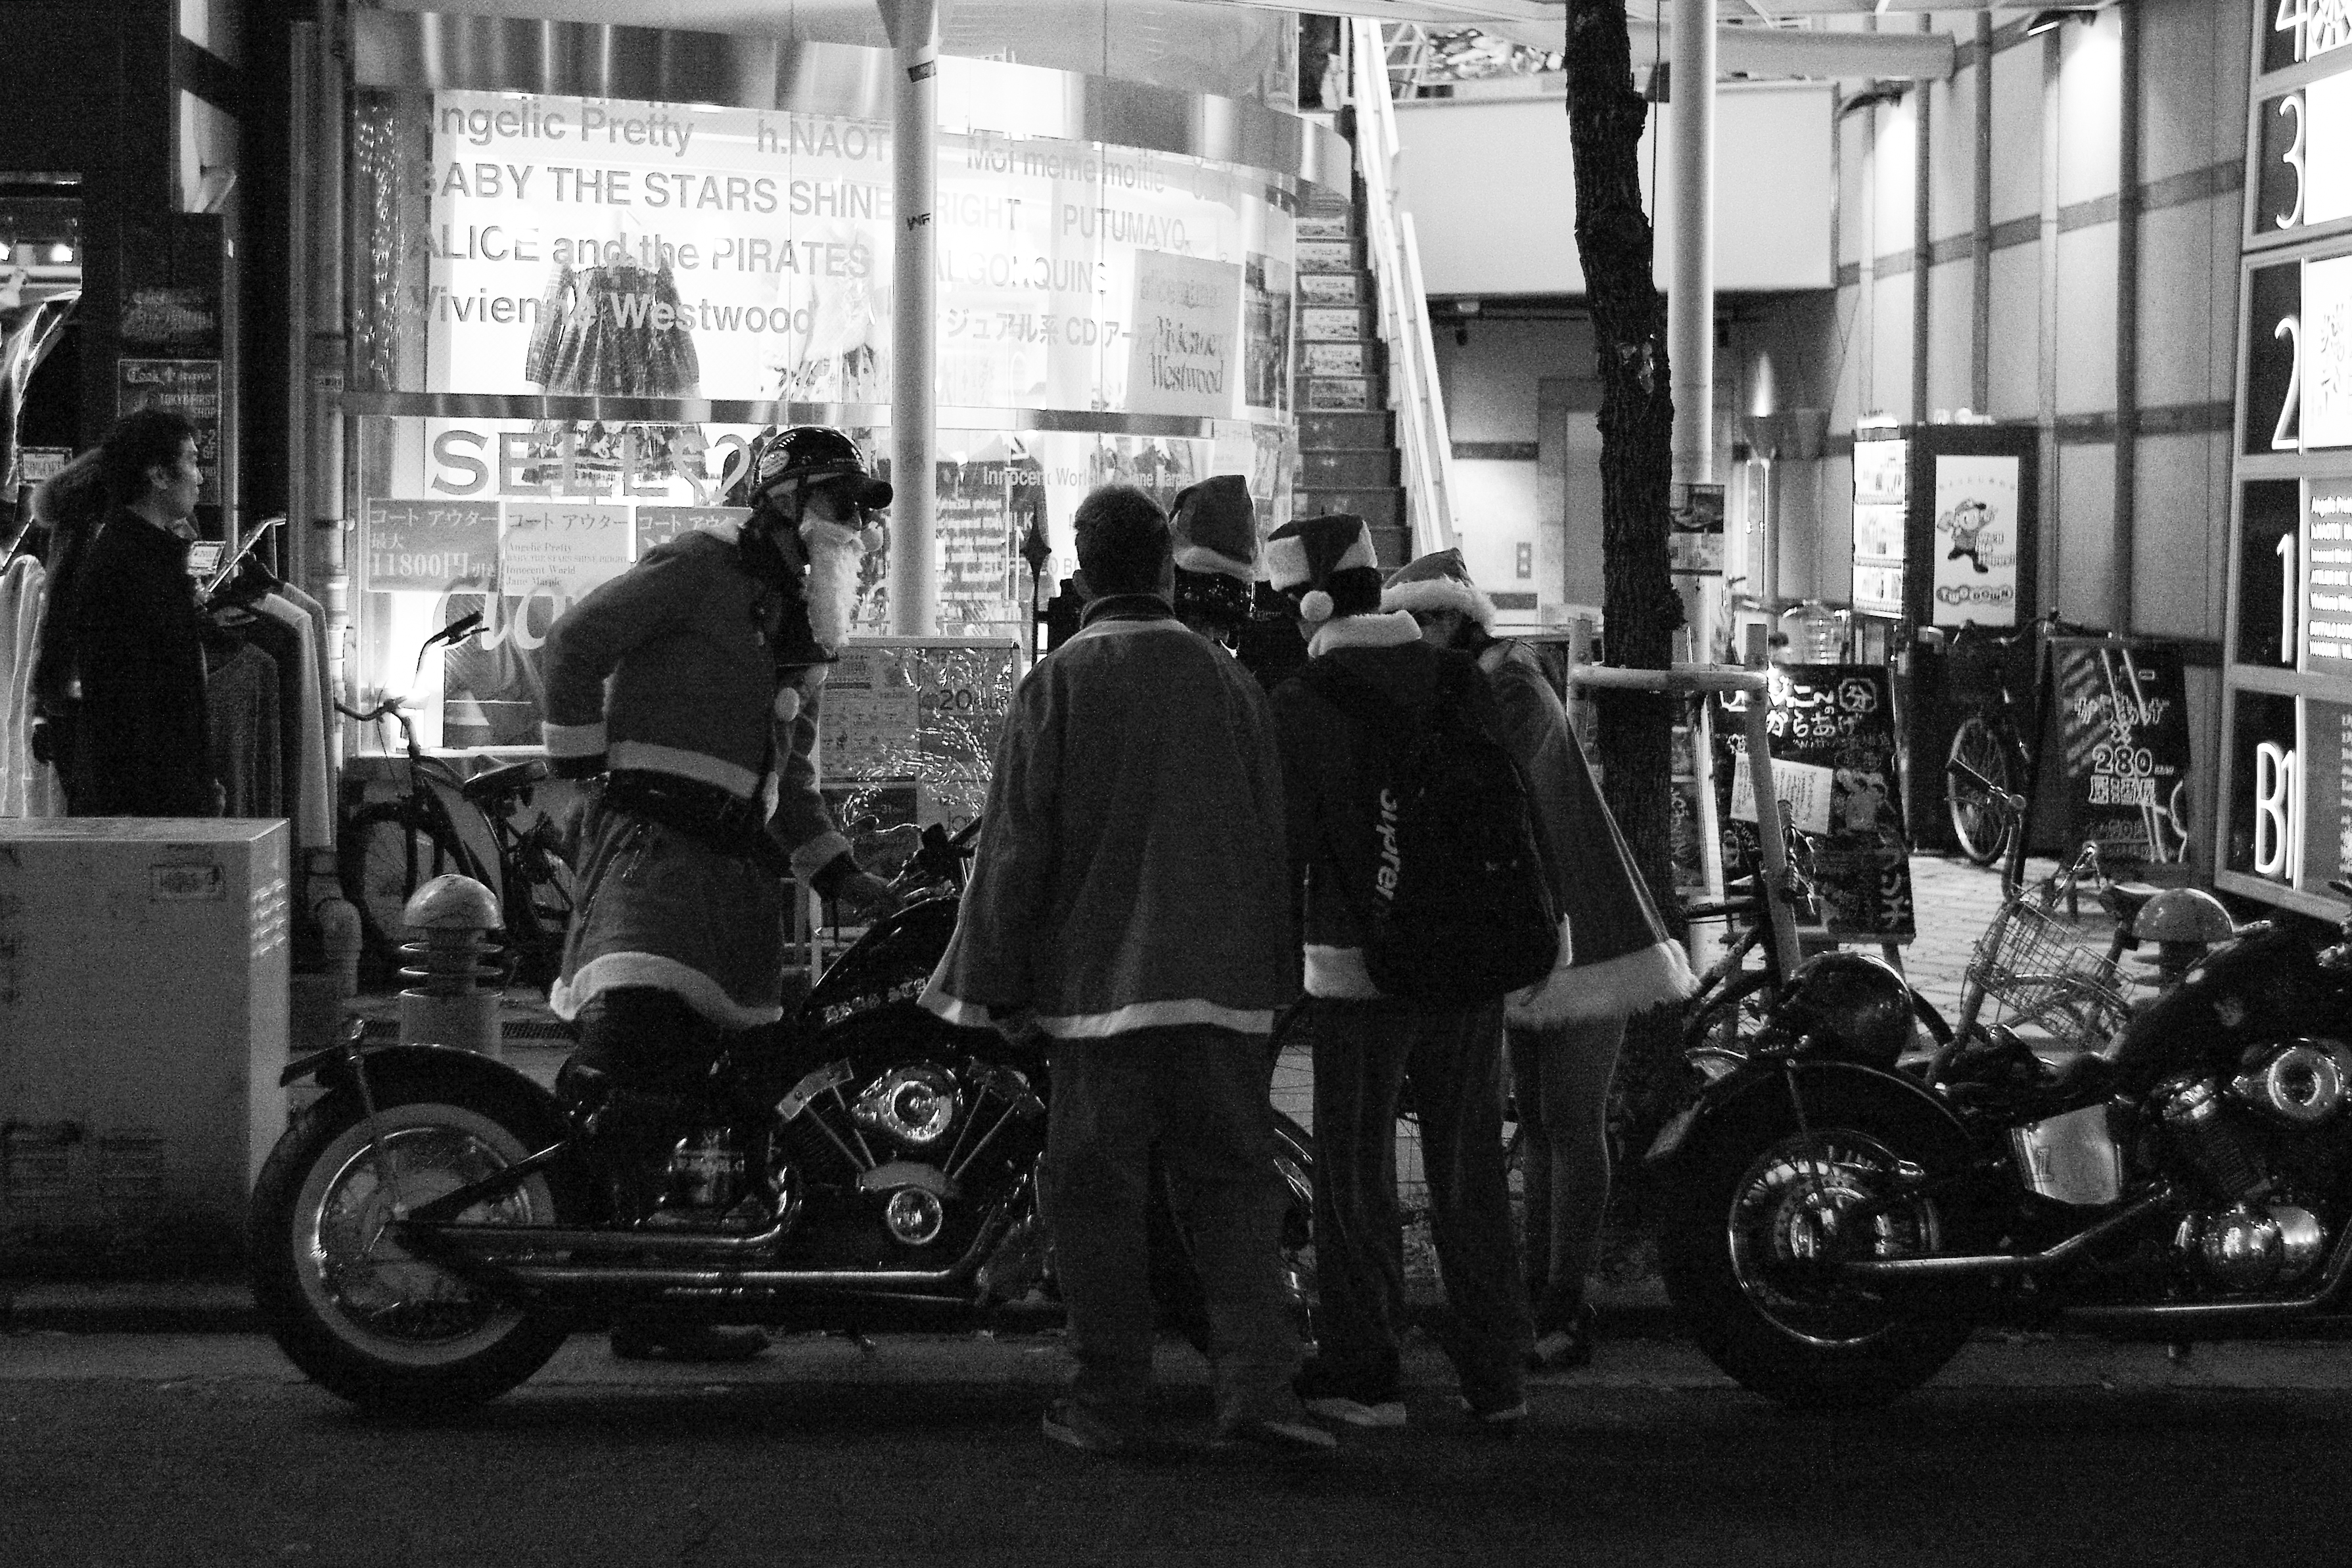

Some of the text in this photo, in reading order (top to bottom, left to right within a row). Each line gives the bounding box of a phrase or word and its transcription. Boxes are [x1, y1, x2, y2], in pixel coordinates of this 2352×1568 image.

[441, 103, 892, 163] ngelic Pretty h.NAOT
[2276, 95, 2303, 229] 3
[407, 160, 1021, 231] BABY THE STARS SHINE RIGHT
[409, 222, 871, 279] ALICE and the PIRATES
[1063, 204, 1186, 250] PUTUMAYO
[410, 285, 814, 334] Vivienne Westwood
[936, 308, 1059, 346] ジュアル系
[1065, 315, 1097, 346] CD
[2271, 317, 2303, 451] 2
[371, 507, 499, 527] コート アウター
[508, 512, 630, 532] コート アウター
[638, 514, 681, 533] コート
[2276, 533, 2291, 664] 1
[2092, 743, 2152, 778] 280
[2255, 742, 2295, 879] B1
[1375, 787, 1401, 901] Supre
